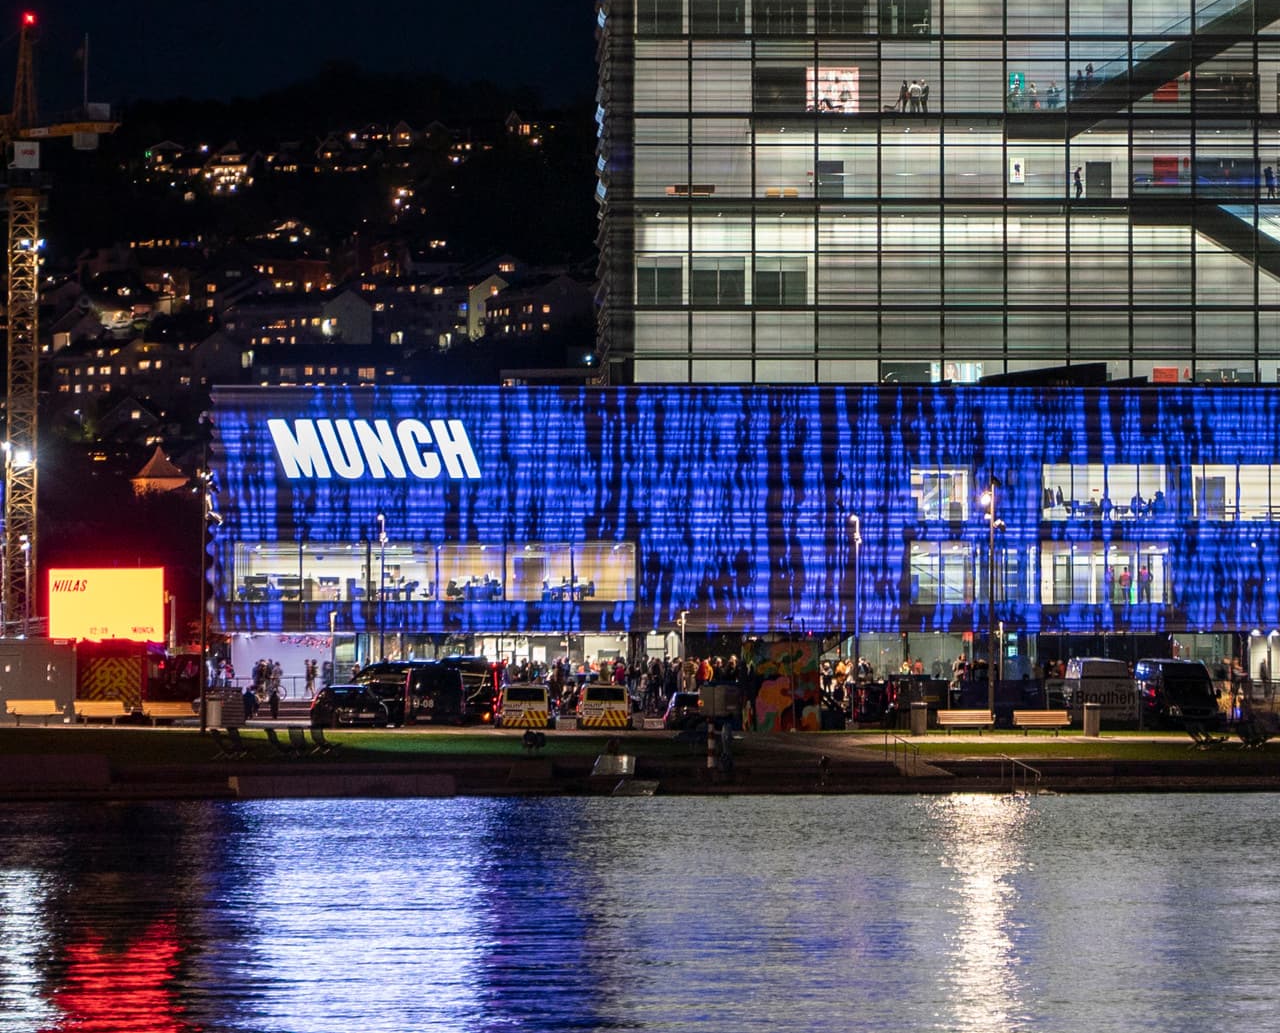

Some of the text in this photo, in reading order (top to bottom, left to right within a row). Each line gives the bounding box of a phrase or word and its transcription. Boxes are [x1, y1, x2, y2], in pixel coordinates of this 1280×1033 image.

[267, 419, 481, 479] MUNCH
[53, 580, 88, 592] NIILAS
[95, 668, 127, 687] 92
